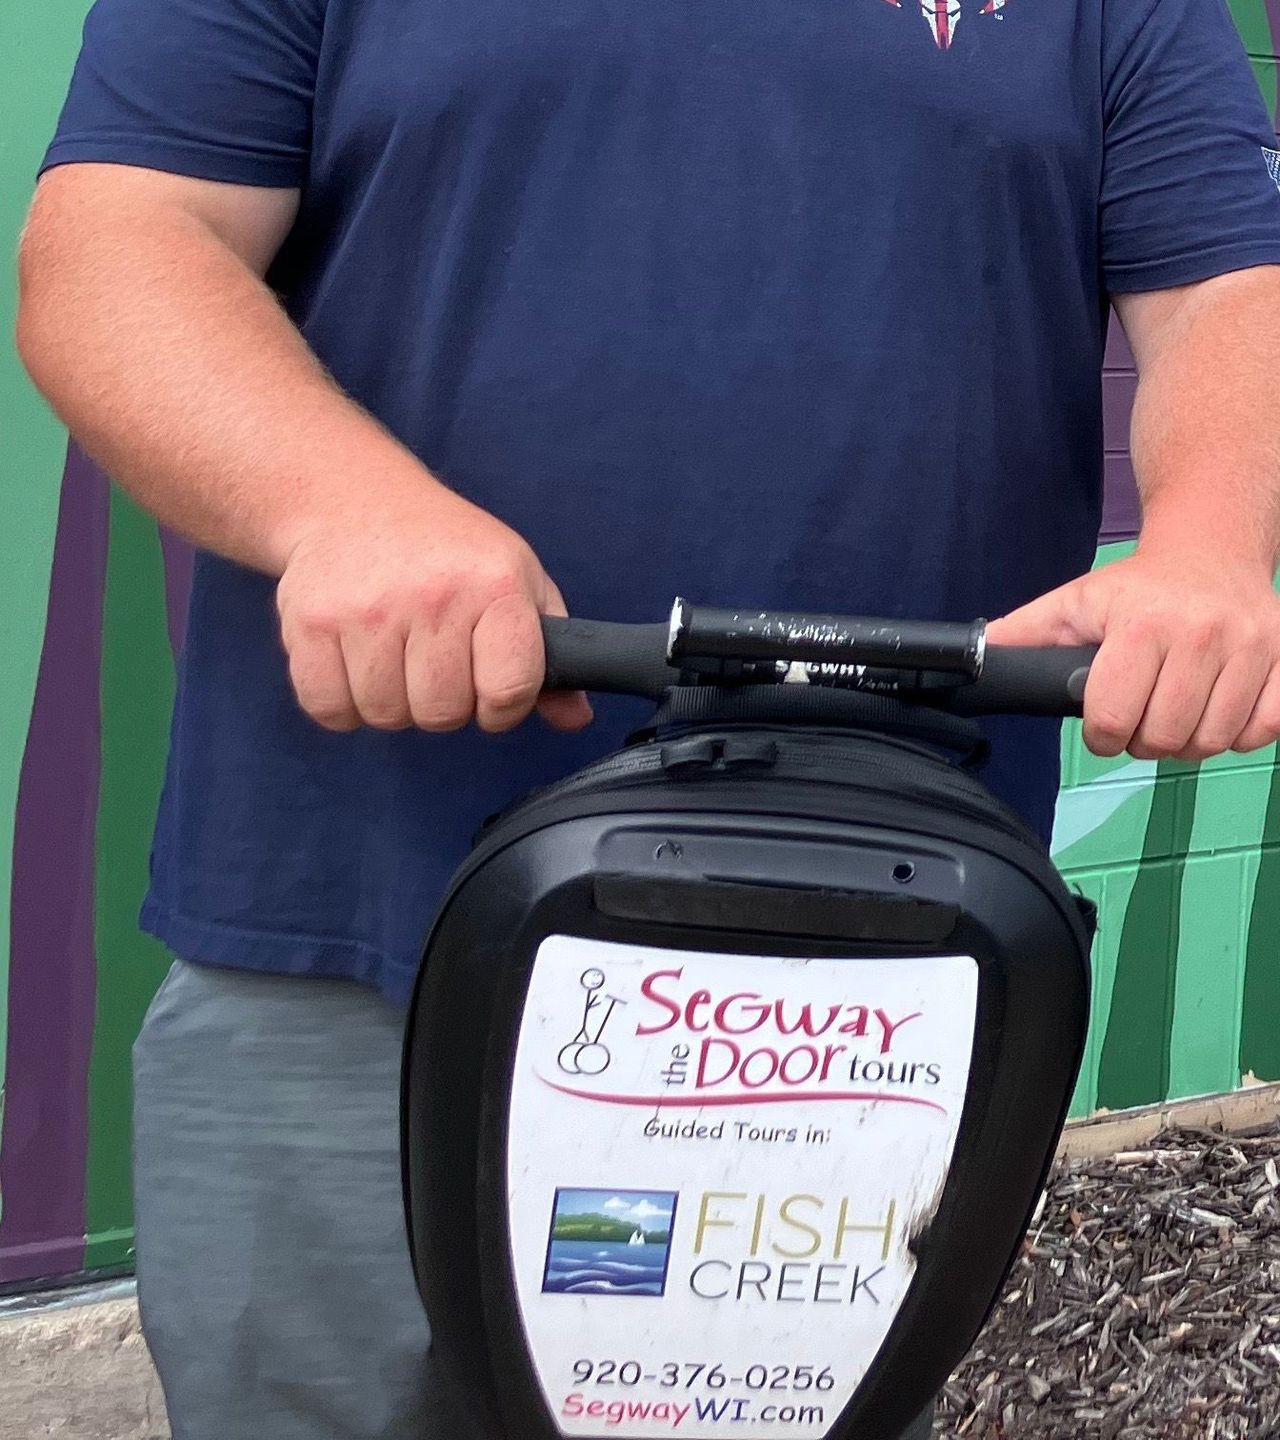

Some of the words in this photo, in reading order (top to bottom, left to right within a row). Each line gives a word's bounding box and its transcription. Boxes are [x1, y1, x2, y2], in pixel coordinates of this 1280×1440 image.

[660, 1043, 691, 1087] the
[849, 1054, 942, 1086] tours
[642, 1116, 725, 1142] Guided
[734, 1122, 798, 1144] Tours
[805, 1124, 832, 1146] in:
[693, 1190, 898, 1261] FISH
[688, 1260, 887, 1305] CREEK
[570, 1359, 836, 1392] 920-376-0256
[560, 1392, 825, 1428] SegwayWI.com
